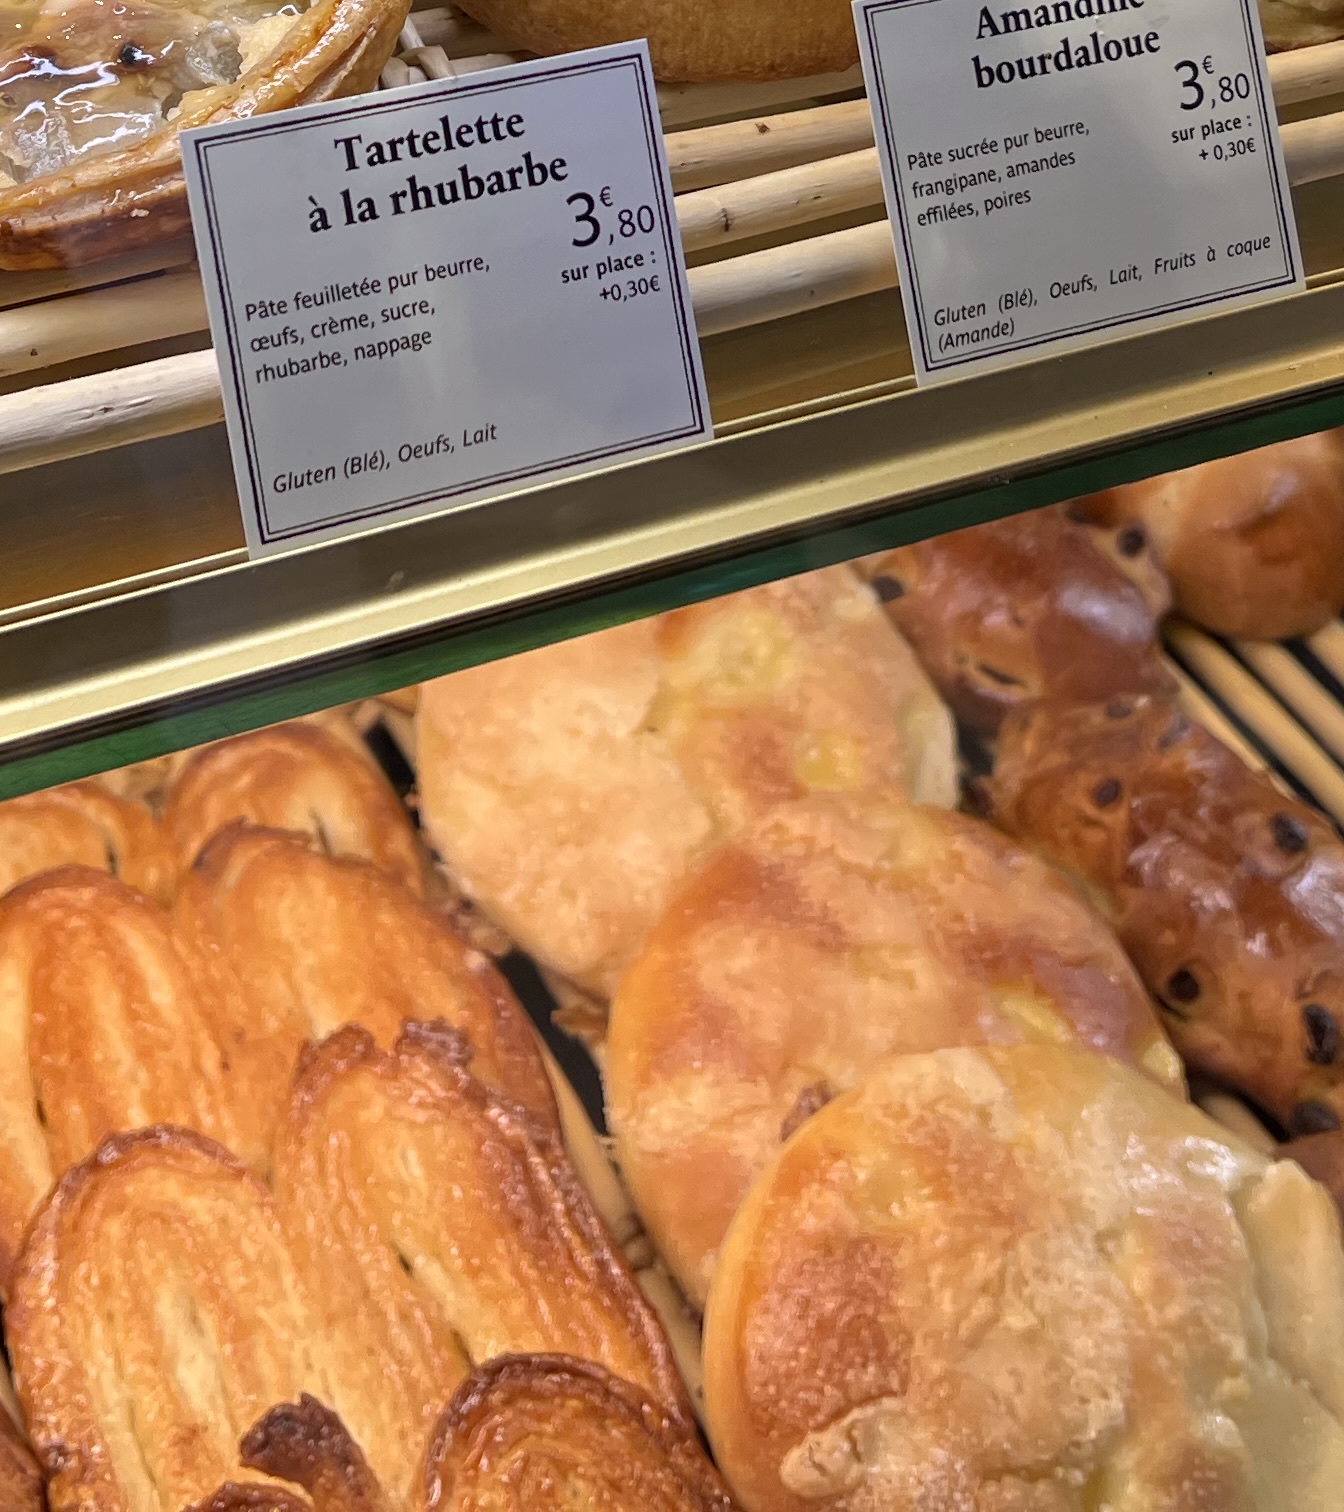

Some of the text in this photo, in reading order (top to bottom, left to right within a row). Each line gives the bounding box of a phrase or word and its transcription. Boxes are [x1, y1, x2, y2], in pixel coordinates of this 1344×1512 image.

[970, 31, 1161, 89] bourdaloue
[333, 112, 525, 172] Tartelette
[907, 121, 1090, 171] Pâte sucrée pur beurre,
[1171, 127, 1195, 144] sur
[1200, 117, 1242, 140] place
[308, 150, 569, 233] à la rhubarbe
[912, 151, 1076, 199] frangipane, amandes
[917, 189, 1032, 227] effilées, poires
[245, 257, 490, 322] Pâte feuilletée pur beurre,
[561, 265, 589, 284] sur
[595, 253, 645, 279] place
[933, 236, 1271, 327] Gluten (Blé), Oeufs, Lait, Fruits à coque
[250, 300, 435, 353] œufs, crème, sucre,
[938, 317, 1015, 354] (Amande)
[255, 331, 432, 384] rhubarbe, nappage
[273, 423, 497, 494] Gluten (Blé), Oeufs, Lait
